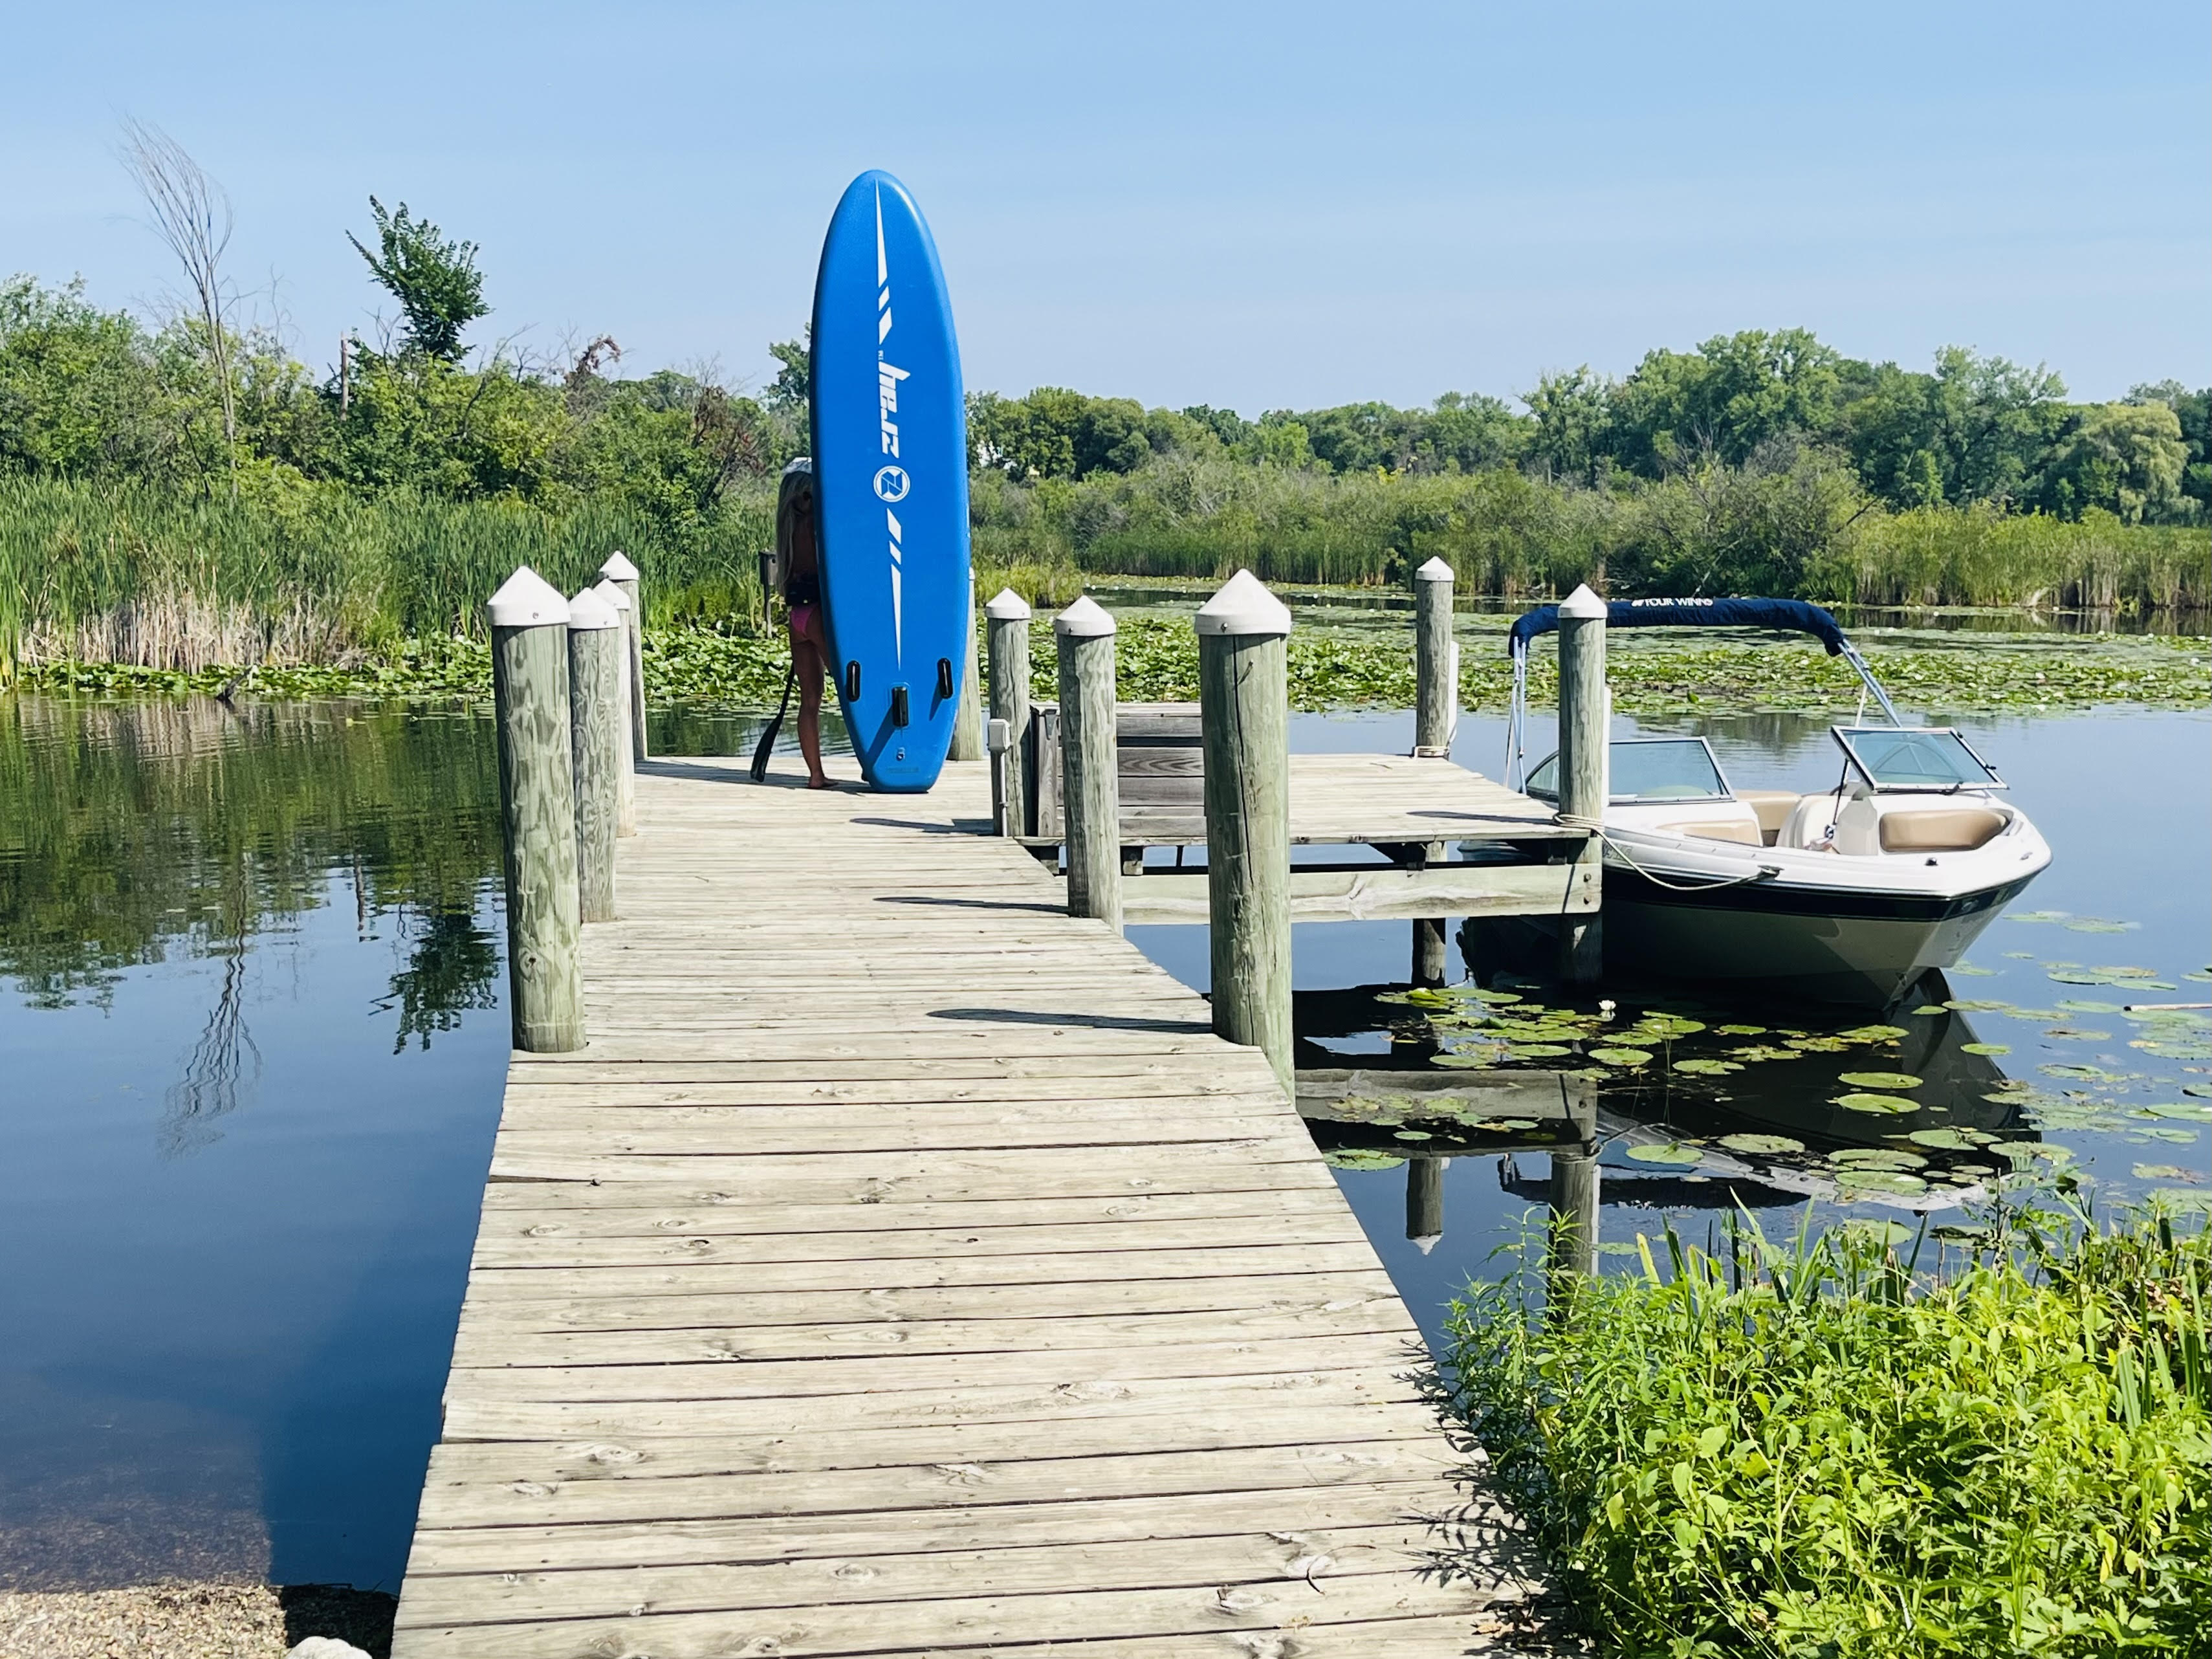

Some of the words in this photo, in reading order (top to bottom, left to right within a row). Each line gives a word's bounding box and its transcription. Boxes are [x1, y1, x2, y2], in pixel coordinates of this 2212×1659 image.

[878, 361, 910, 458] zray
[1645, 598, 1674, 606] FOUR
[1675, 598, 1713, 606] WINNS
